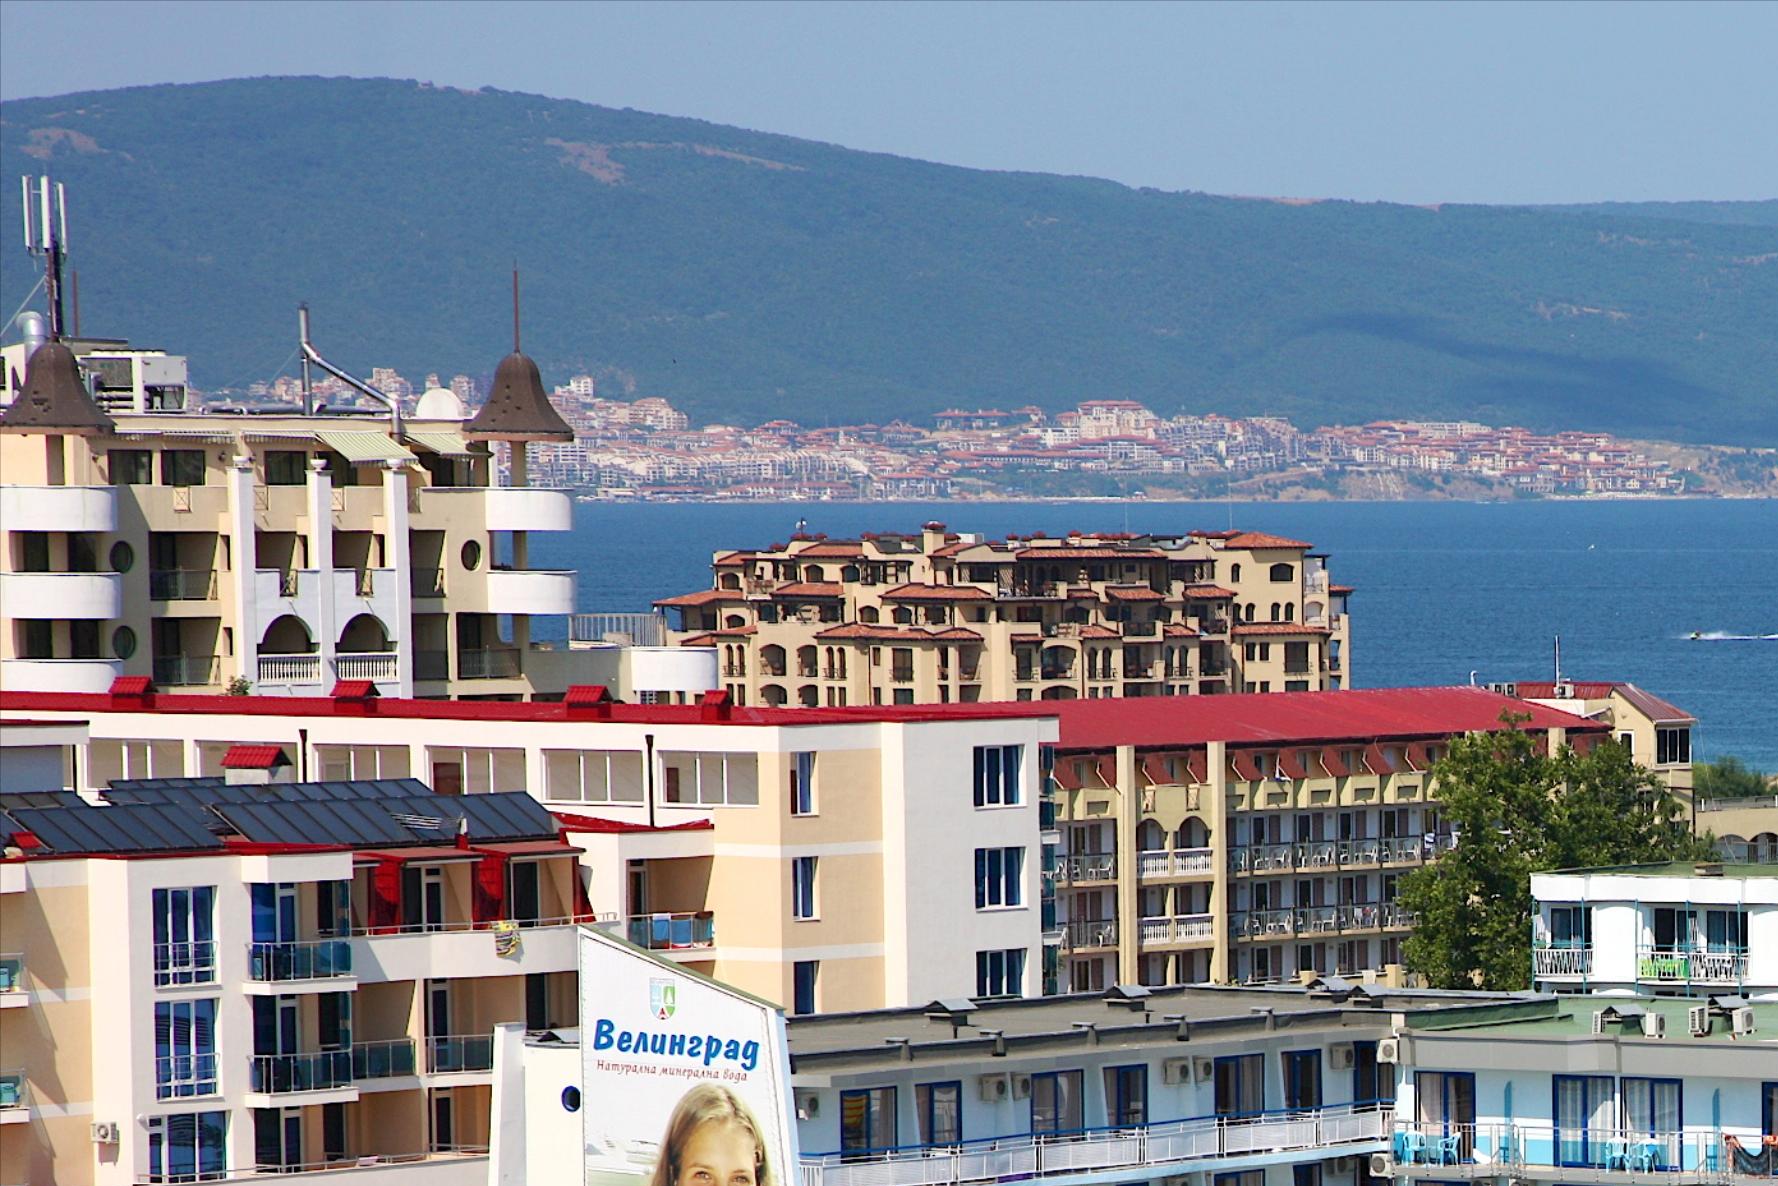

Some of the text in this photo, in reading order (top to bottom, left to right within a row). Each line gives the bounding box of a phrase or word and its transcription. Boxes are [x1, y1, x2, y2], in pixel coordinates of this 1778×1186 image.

[593, 1019, 760, 1071] Велинград
[597, 1059, 748, 1084] Натурална минерална вода
